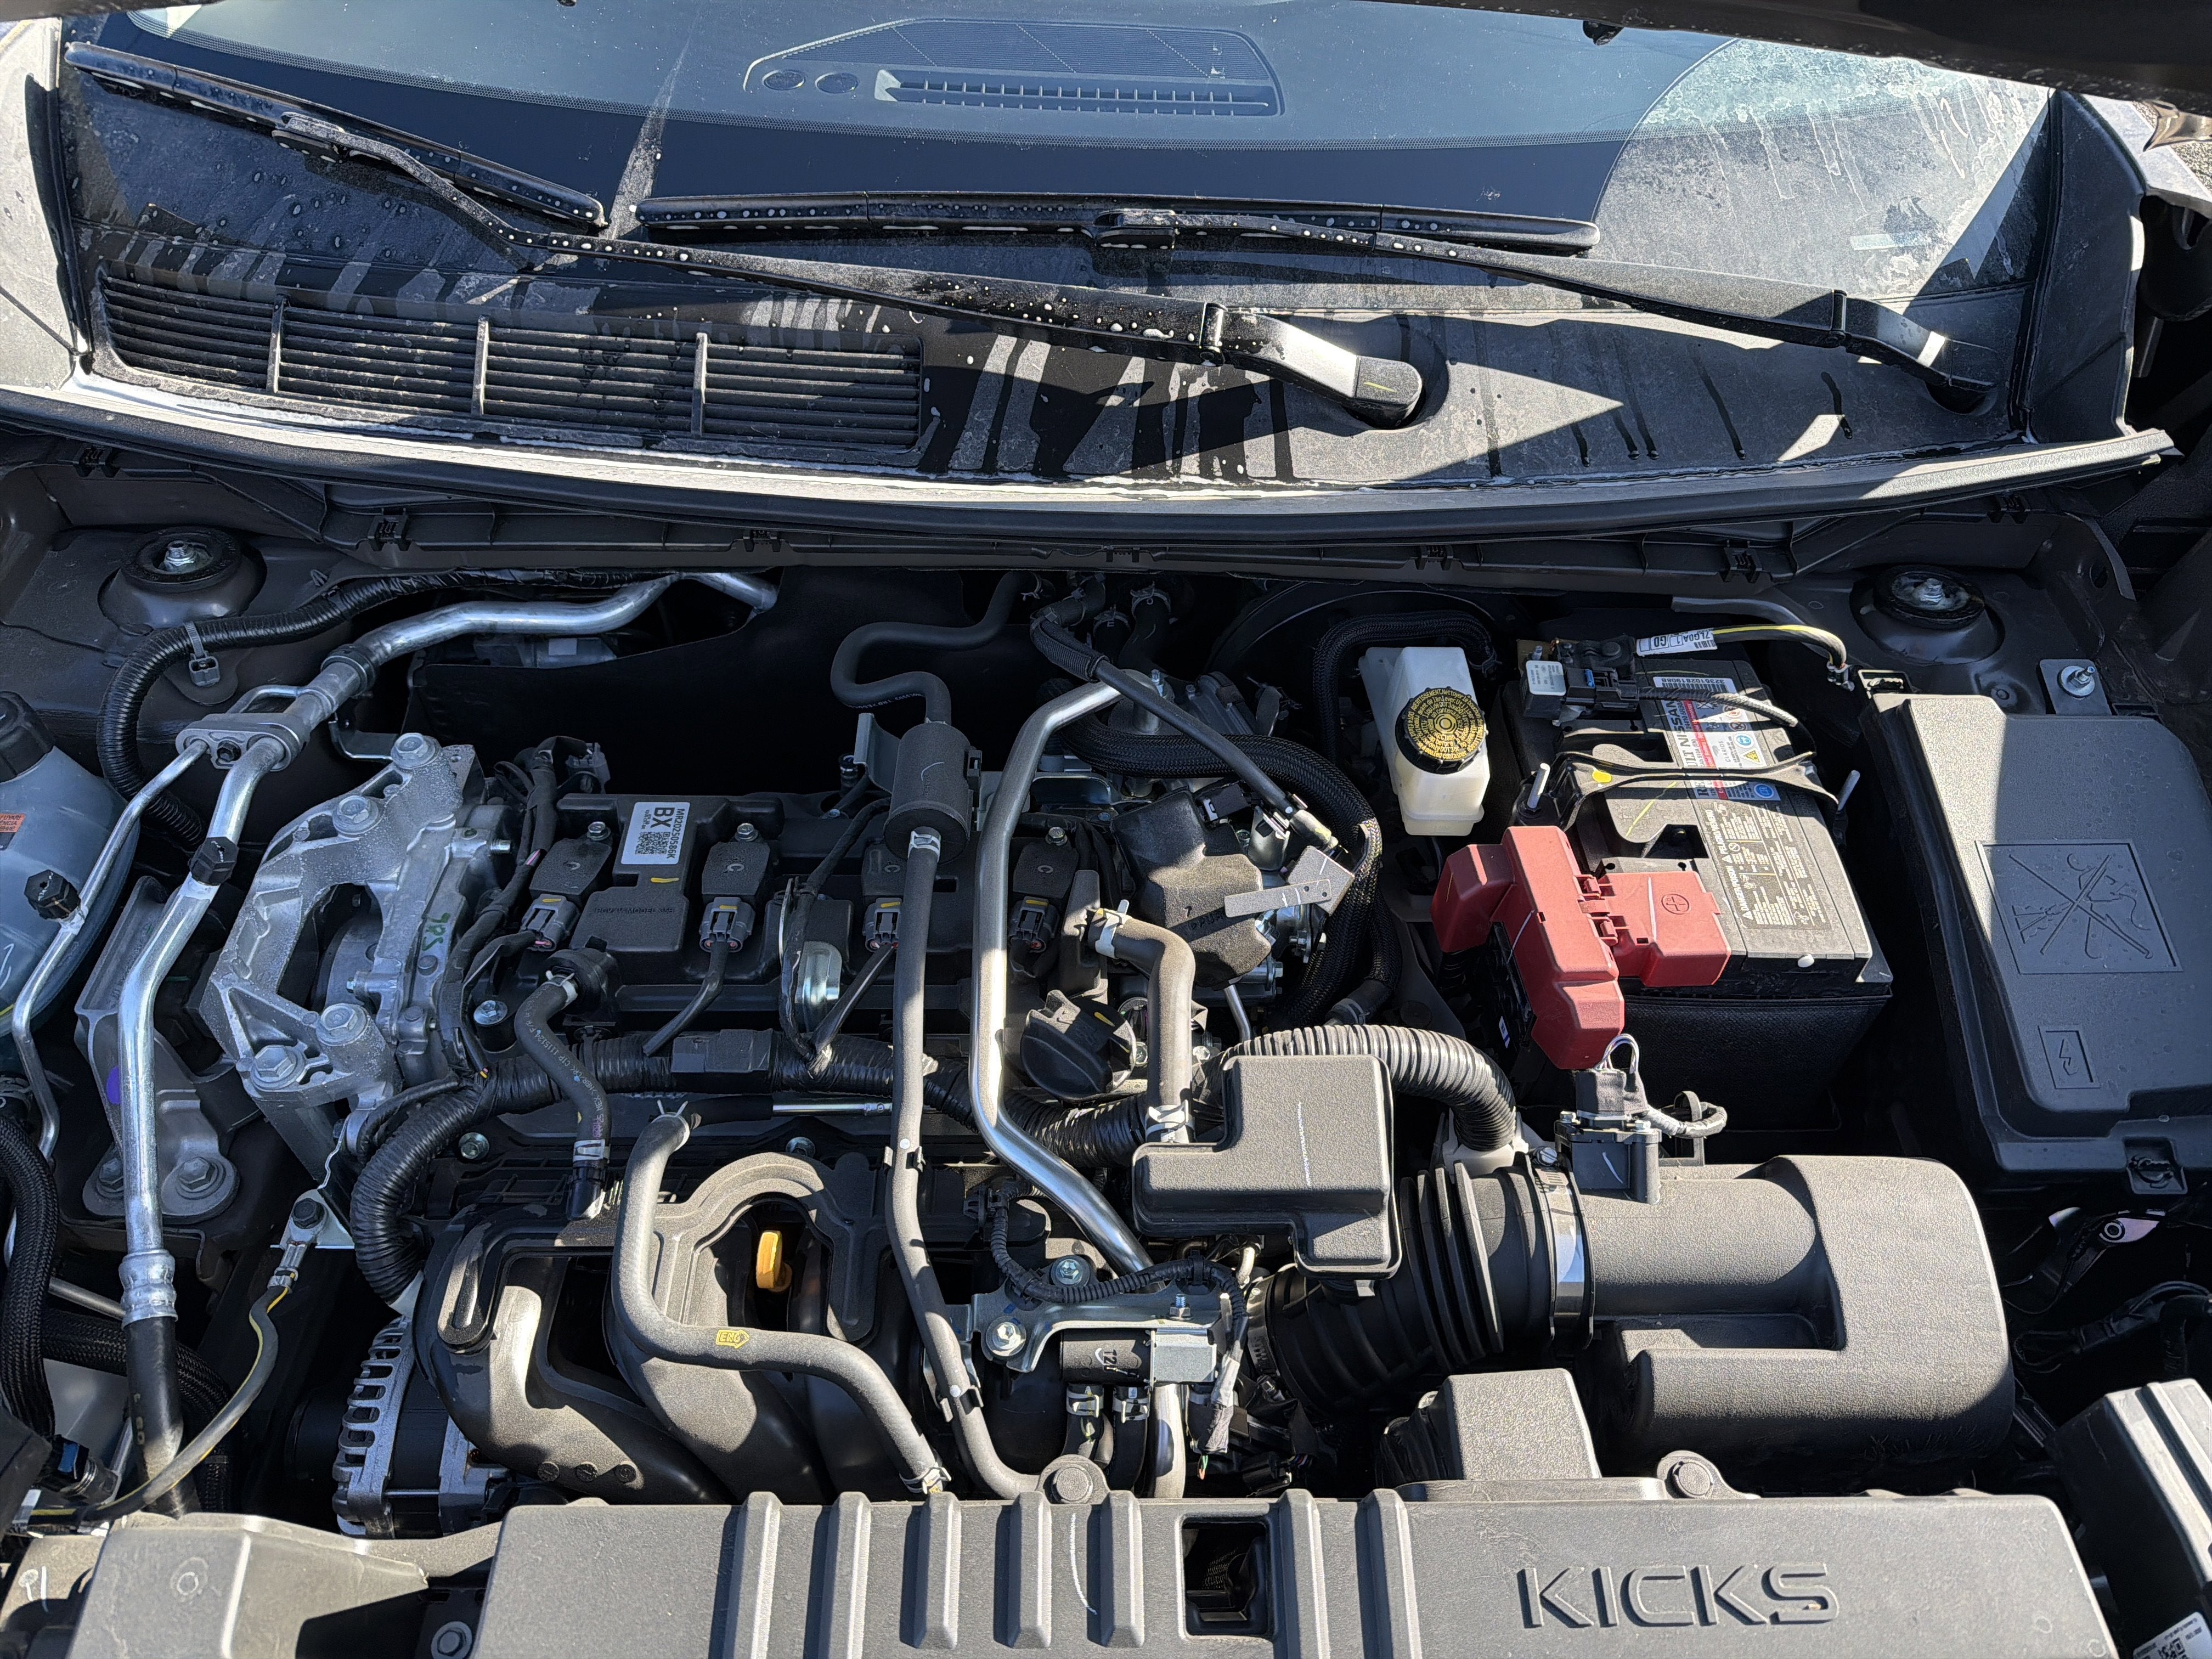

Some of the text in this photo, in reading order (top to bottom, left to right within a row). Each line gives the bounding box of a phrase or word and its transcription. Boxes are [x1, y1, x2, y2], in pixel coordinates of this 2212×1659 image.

[1718, 741, 1731, 763] CLARIOS
[650, 807, 675, 828] BX
[667, 808, 685, 859] MR20250586K
[720, 1332, 741, 1343] ENG
[1517, 1562, 1839, 1629] KICKS
